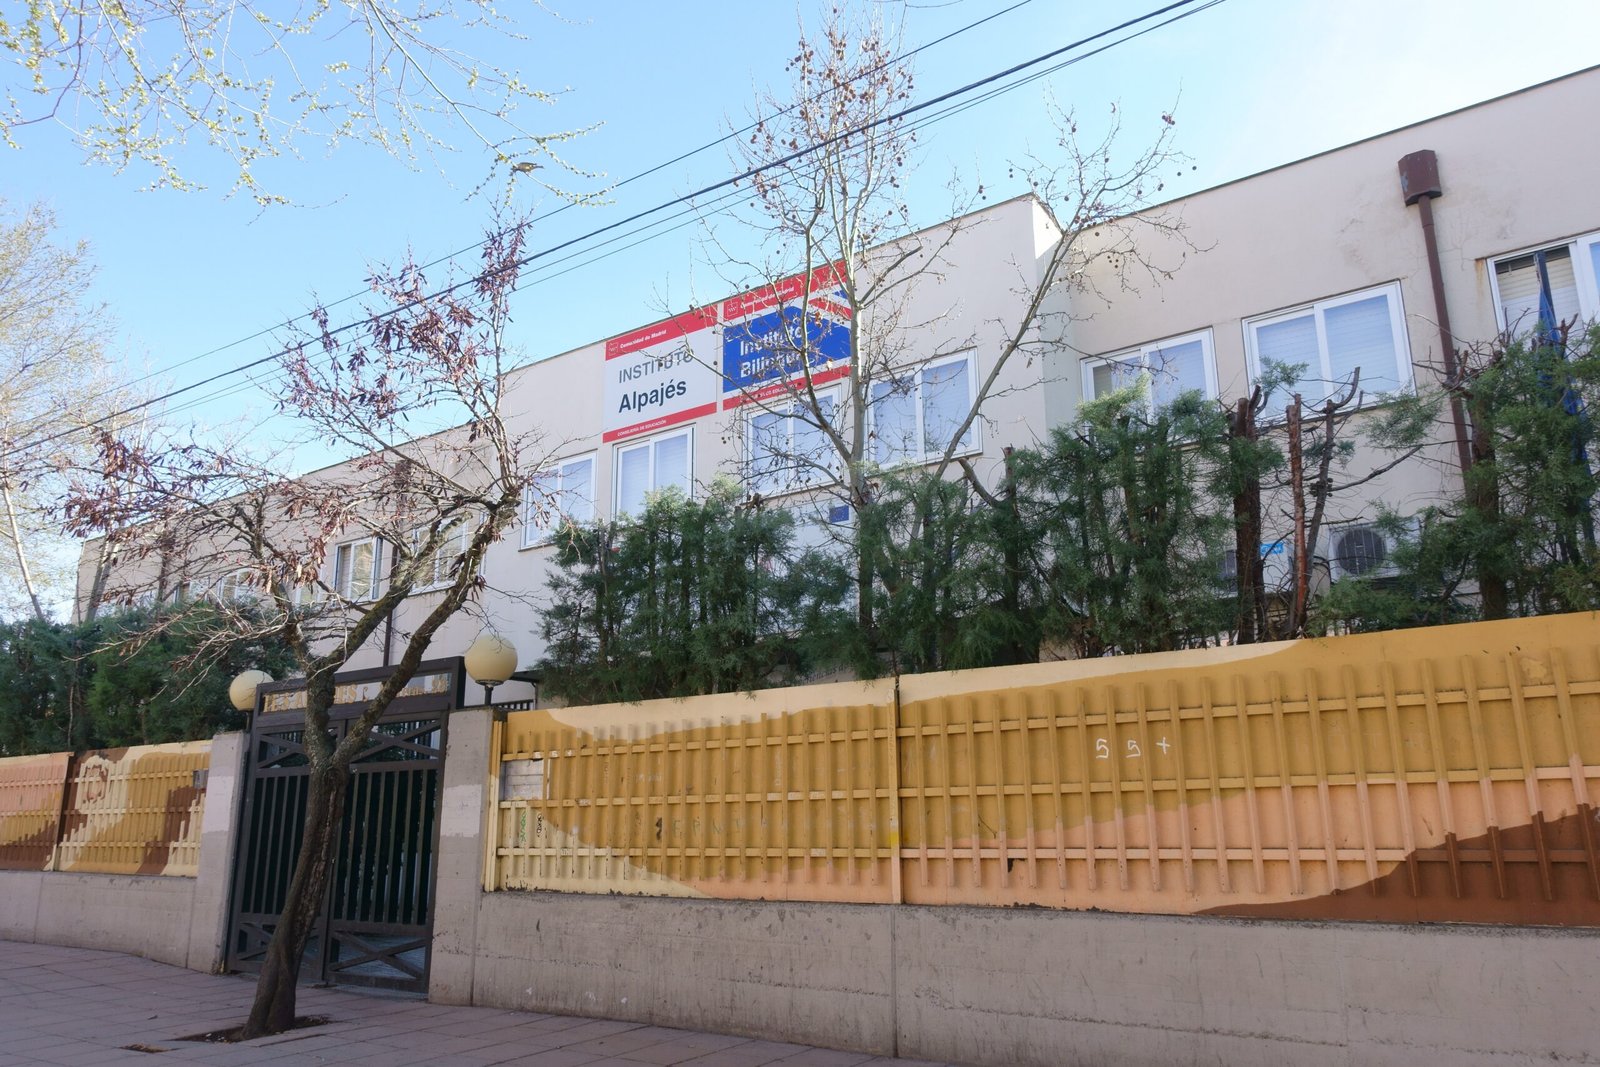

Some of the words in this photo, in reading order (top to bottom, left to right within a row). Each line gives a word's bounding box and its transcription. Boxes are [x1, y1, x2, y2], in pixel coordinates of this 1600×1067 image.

[620, 337, 644, 348] Comunidad
[651, 330, 667, 338] Madrid
[619, 350, 693, 383] INSTITUTO
[619, 379, 687, 413] Alpajés
